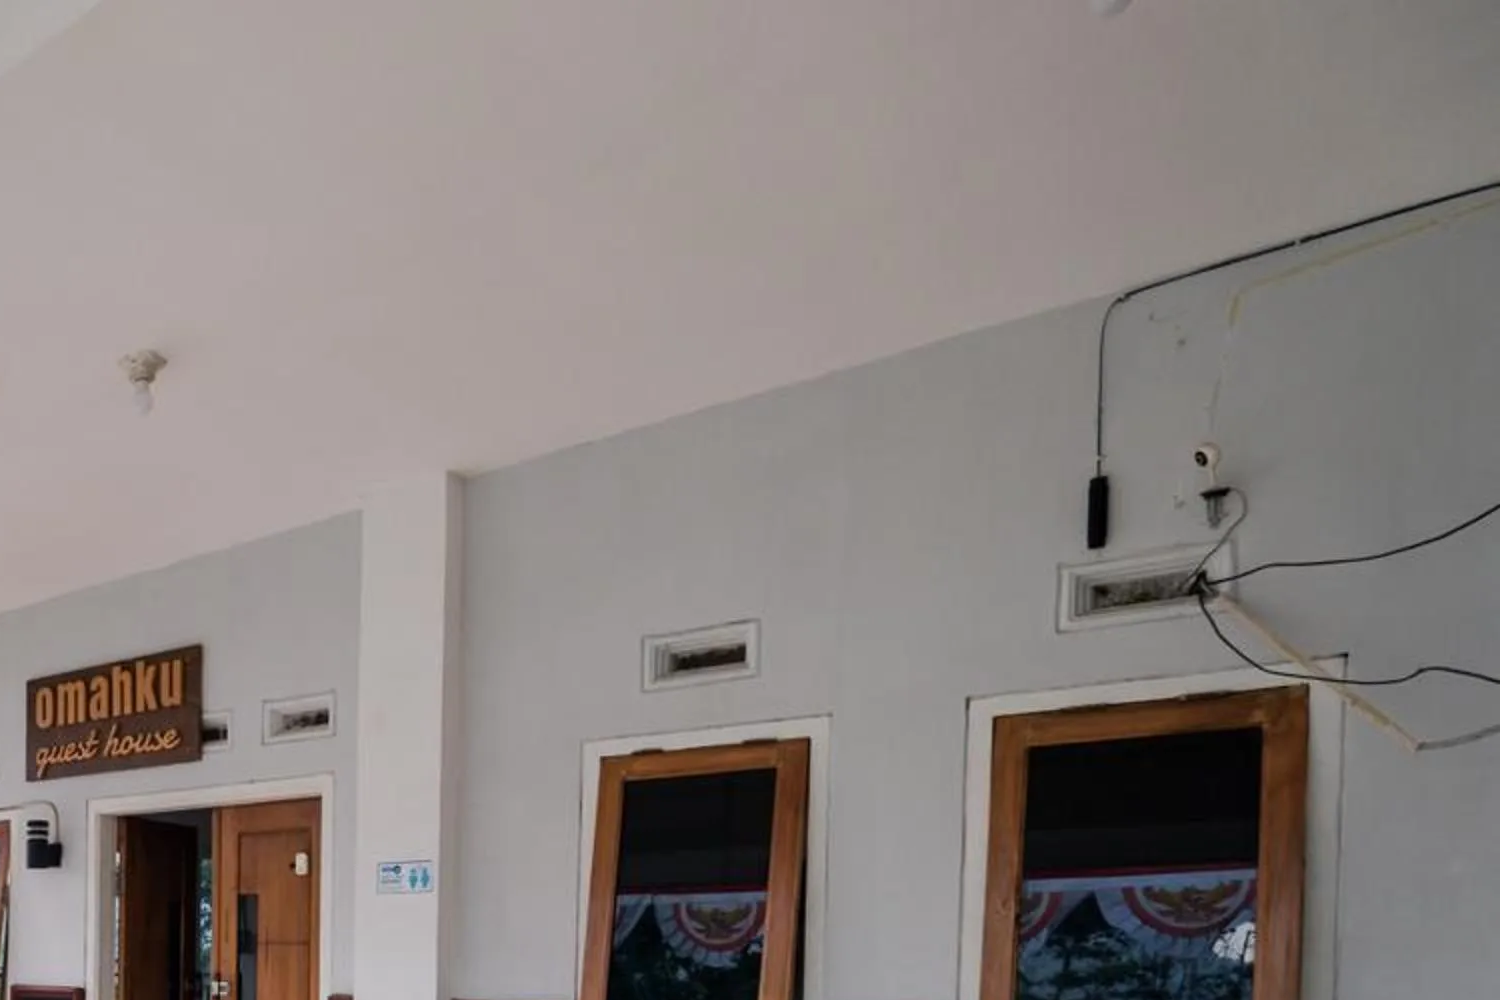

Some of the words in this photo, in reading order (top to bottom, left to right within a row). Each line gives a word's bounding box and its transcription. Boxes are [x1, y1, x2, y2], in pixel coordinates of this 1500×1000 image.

[35, 659, 183, 729] omahku
[36, 730, 99, 778] guest
[103, 724, 181, 757] house
